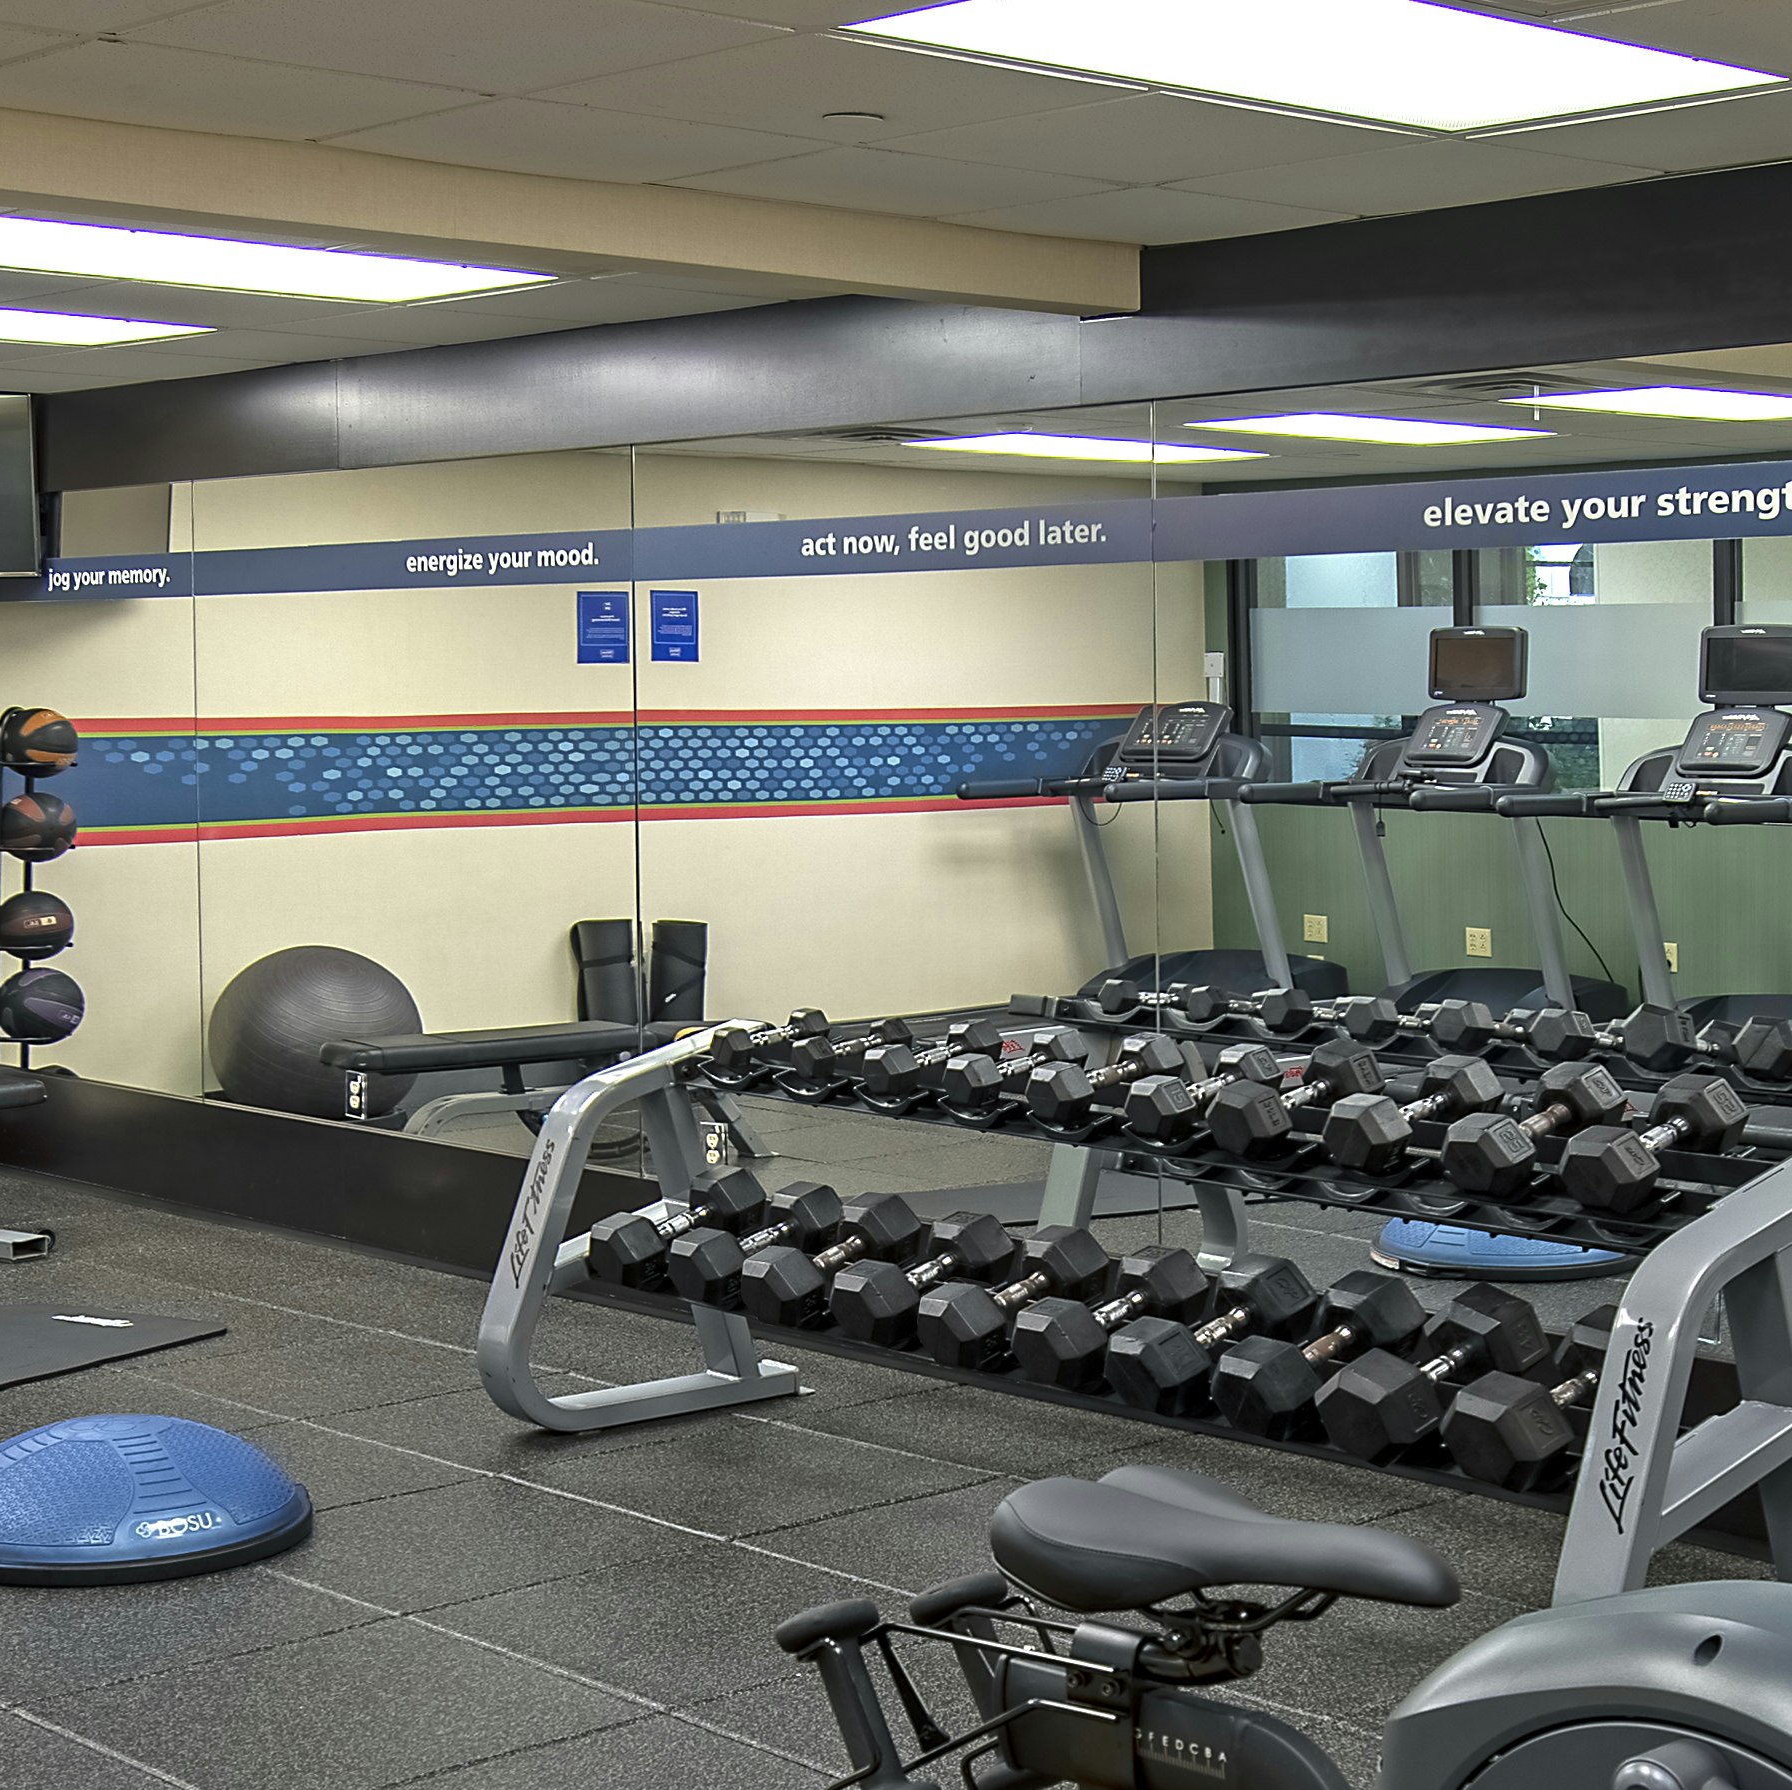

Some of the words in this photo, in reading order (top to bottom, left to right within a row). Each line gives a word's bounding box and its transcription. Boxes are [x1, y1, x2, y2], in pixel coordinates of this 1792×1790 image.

[1423, 495, 1550, 527] elevate
[1561, 492, 1646, 529] your
[801, 532, 836, 556] act
[843, 533, 900, 555] now,
[908, 525, 955, 551] feel
[963, 520, 1030, 555] good
[1038, 519, 1107, 545] later.
[406, 549, 483, 576] energize
[488, 550, 532, 575] your
[537, 542, 599, 567] mood.
[48, 568, 70, 591] jog
[73, 570, 105, 591] your
[108, 568, 170, 588] memory.
[159, 1512, 213, 1537] BOSU
[1148, 1731, 1155, 1741] F
[1162, 1735, 1169, 1747] E
[1175, 1739, 1184, 1751] D
[1189, 1743, 1199, 1755] C
[1204, 1746, 1212, 1759] B
[1218, 1751, 1227, 1763] A
